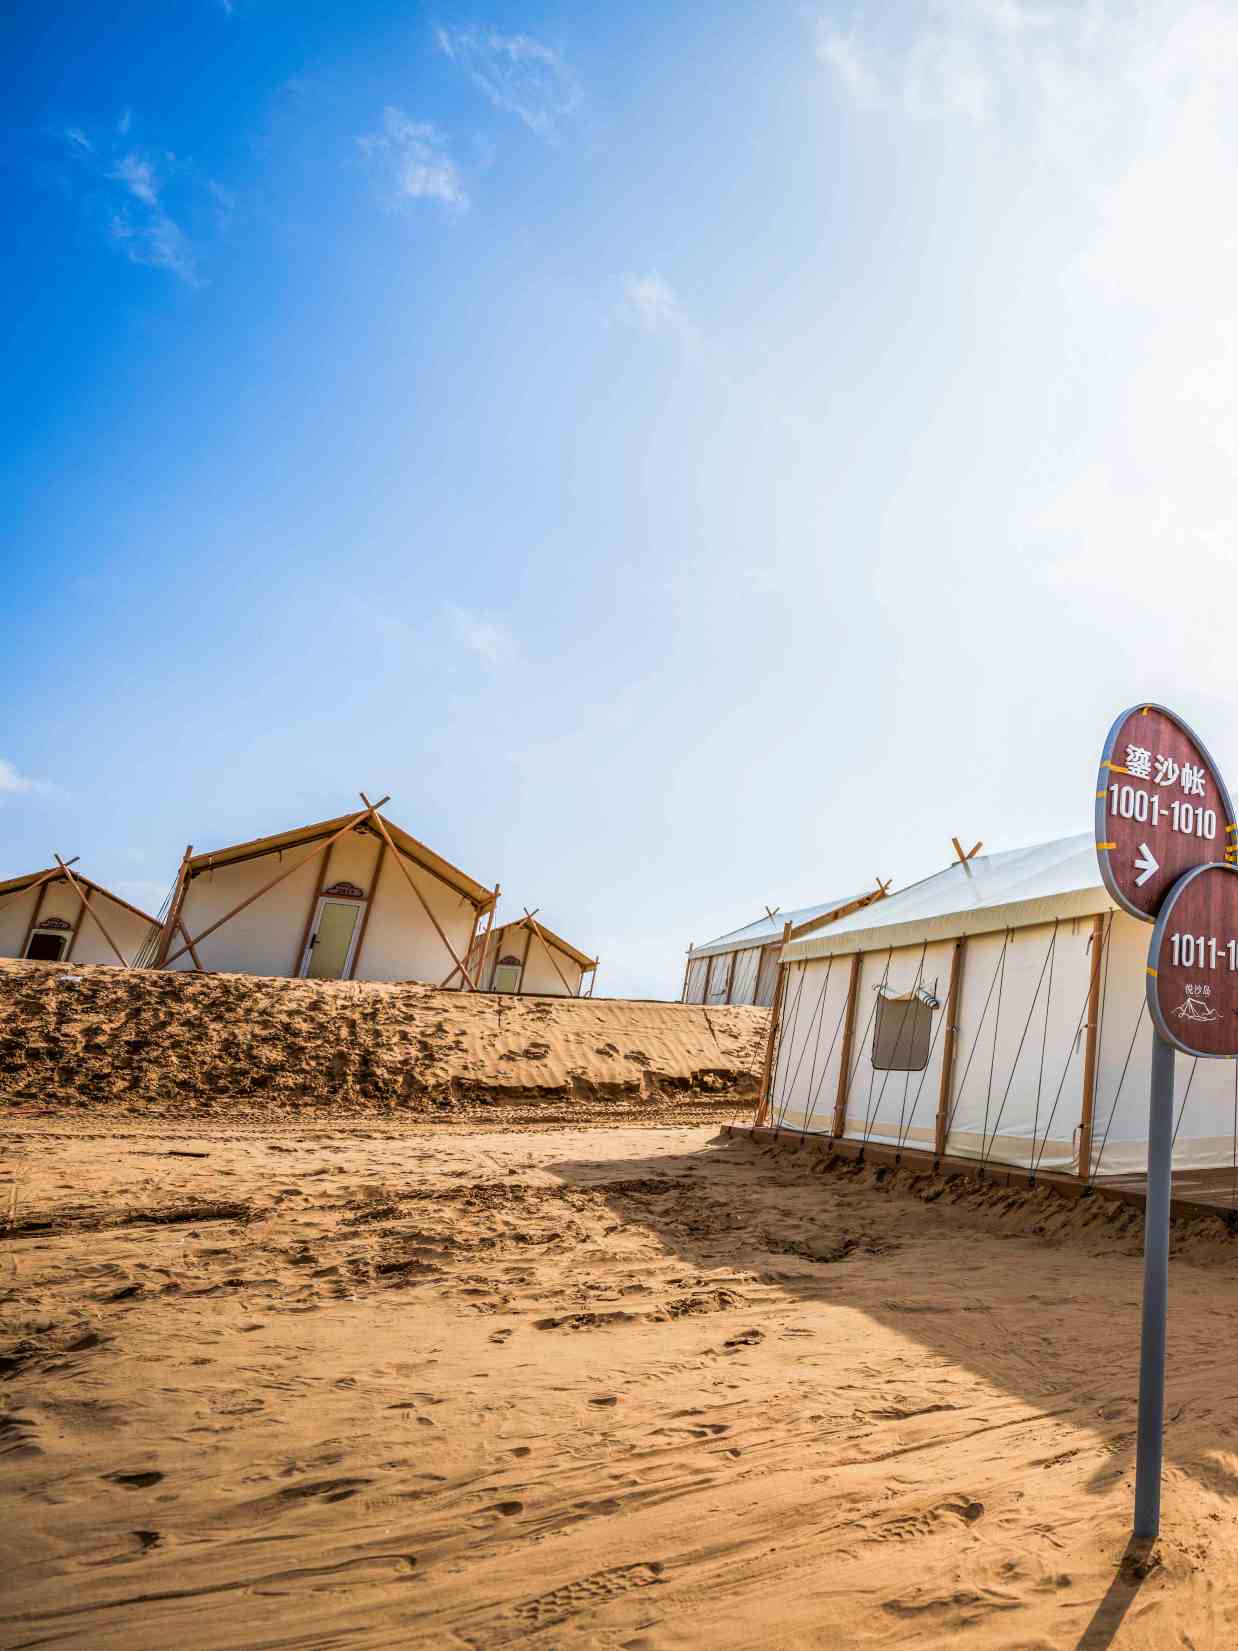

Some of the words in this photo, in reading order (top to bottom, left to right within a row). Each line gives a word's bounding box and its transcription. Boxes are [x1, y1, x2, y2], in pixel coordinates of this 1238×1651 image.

[1125, 744, 1206, 797] 鎏沙帐
[1110, 784, 1217, 840] 1001-1010
